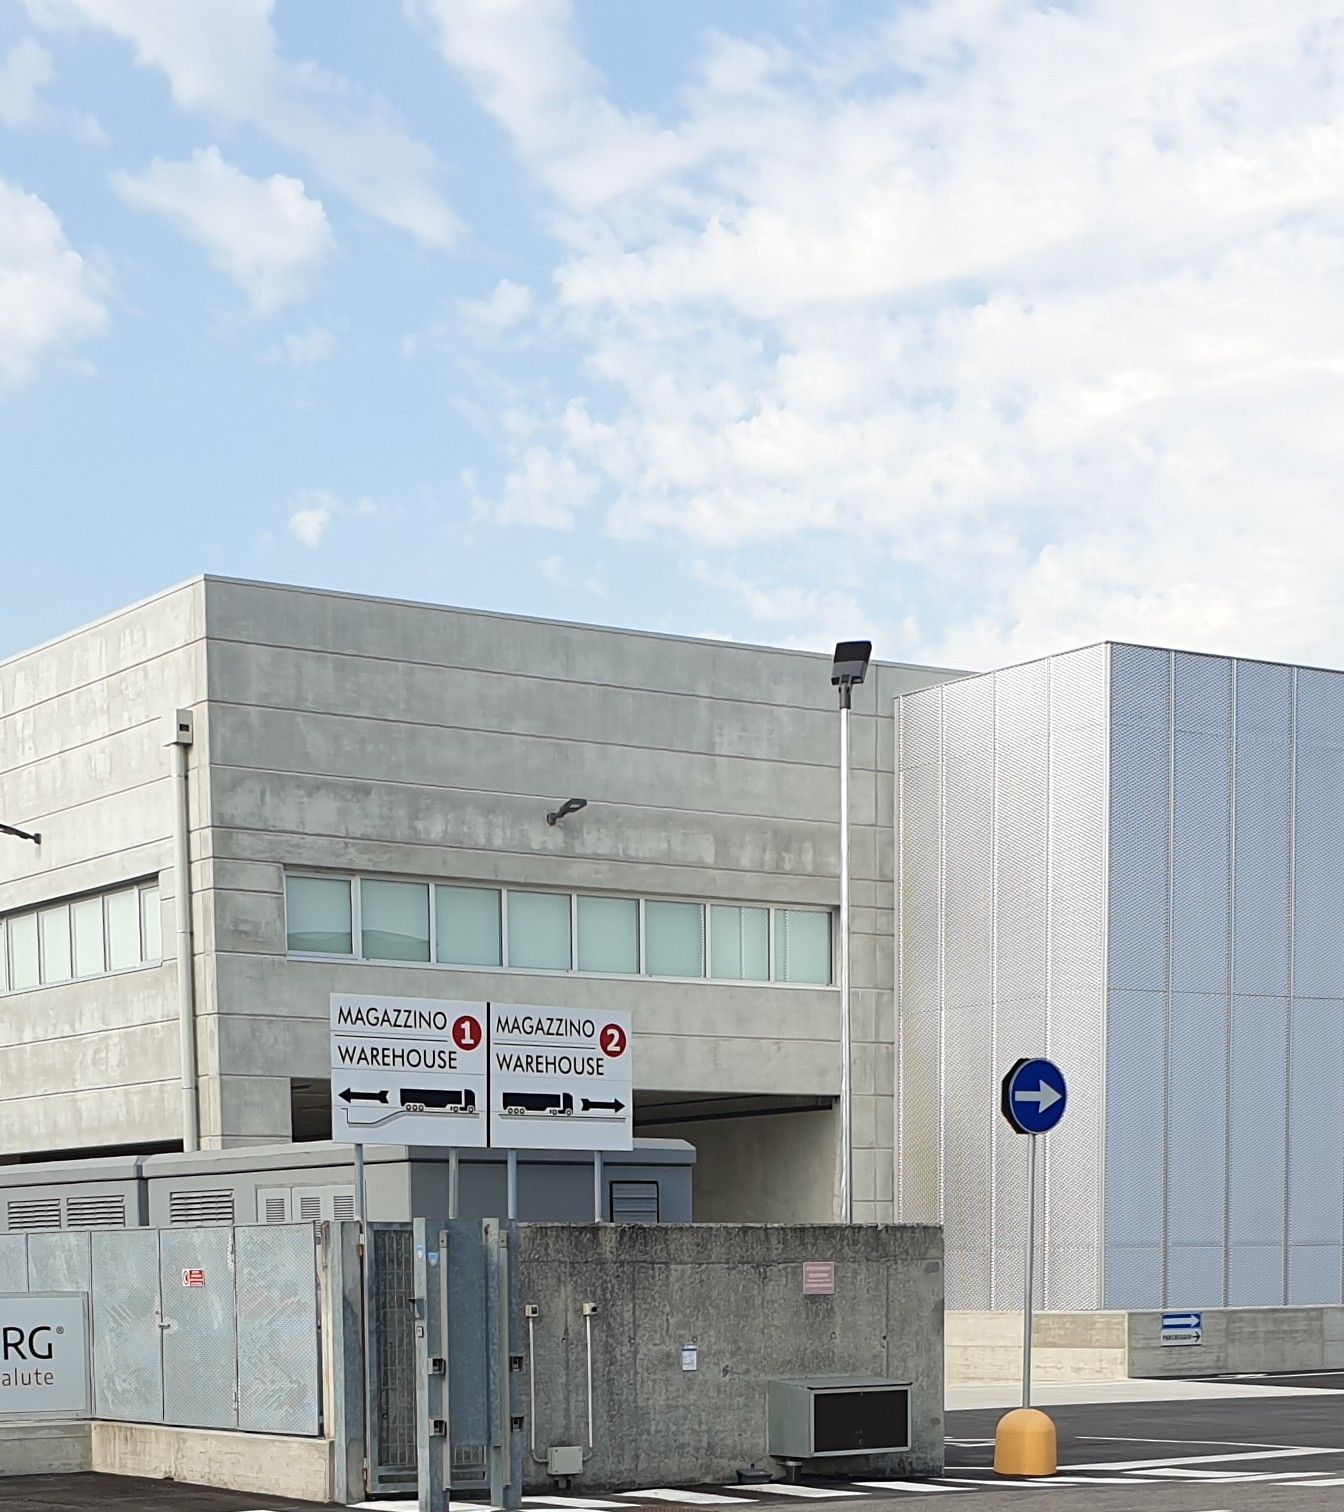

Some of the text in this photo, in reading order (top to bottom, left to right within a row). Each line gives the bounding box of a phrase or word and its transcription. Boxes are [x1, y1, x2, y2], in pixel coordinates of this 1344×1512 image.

[337, 1006, 474, 1045] MAGAZZINO 1
[496, 1015, 621, 1052] MAGAZZINO 2
[337, 1045, 457, 1070] WAREHOUSE
[496, 1053, 605, 1076] WAREHOUSE
